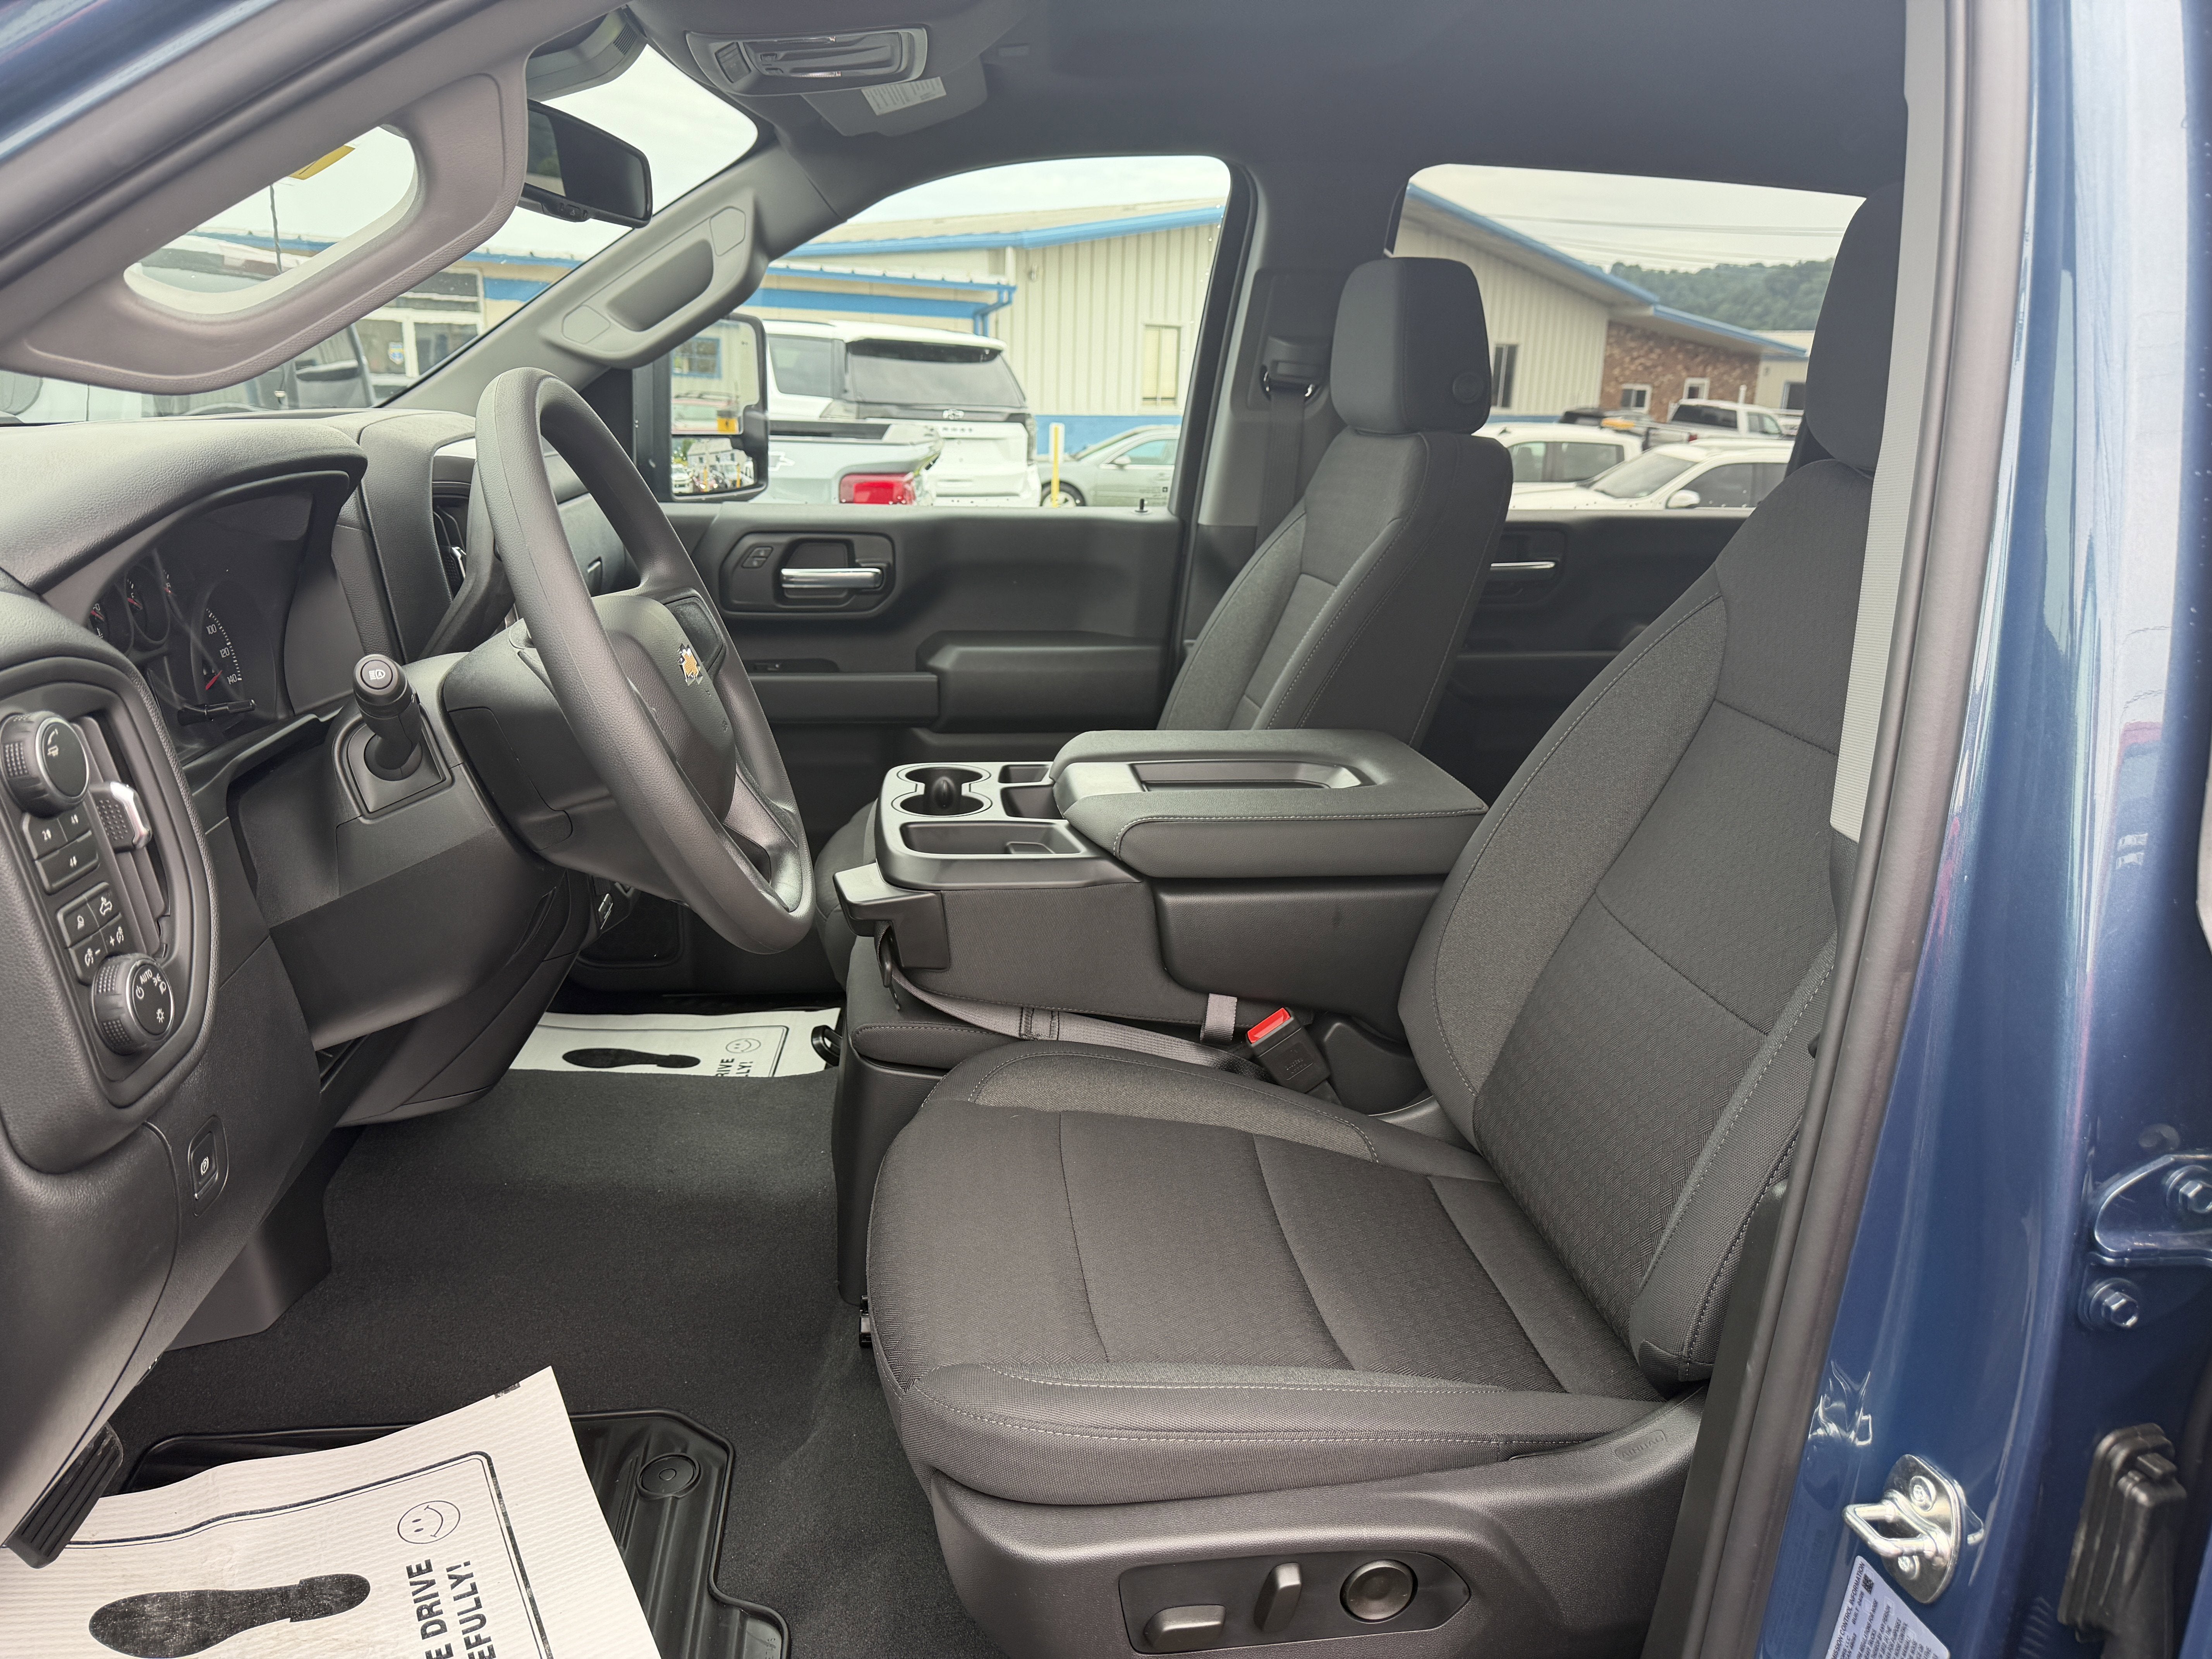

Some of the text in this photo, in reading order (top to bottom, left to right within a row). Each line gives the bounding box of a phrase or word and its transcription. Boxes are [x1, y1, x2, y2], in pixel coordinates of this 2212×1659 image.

[206, 624, 217, 634] 100
[220, 647, 230, 658] 120
[227, 674, 237, 684] 140
[140, 969, 153, 984] AUTO
[736, 1061, 753, 1077] LY!
[1621, 1434, 1664, 1458] AIRBAG
[406, 1559, 447, 1640] DRIVE
[1840, 1606, 1852, 1635] CONTROL
[1849, 1561, 1865, 1606] INFORMATION
[1877, 1632, 1882, 1641] BY
[1882, 1604, 1891, 1625] PERSON
[1891, 1617, 1901, 1644] PURPOSES
[1898, 1622, 1908, 1643] CONTROL
[1859, 1621, 1871, 1653] REGULATIONS
[1867, 1628, 1876, 1647] TRUCKS
[1918, 1644, 1923, 1652] OR
